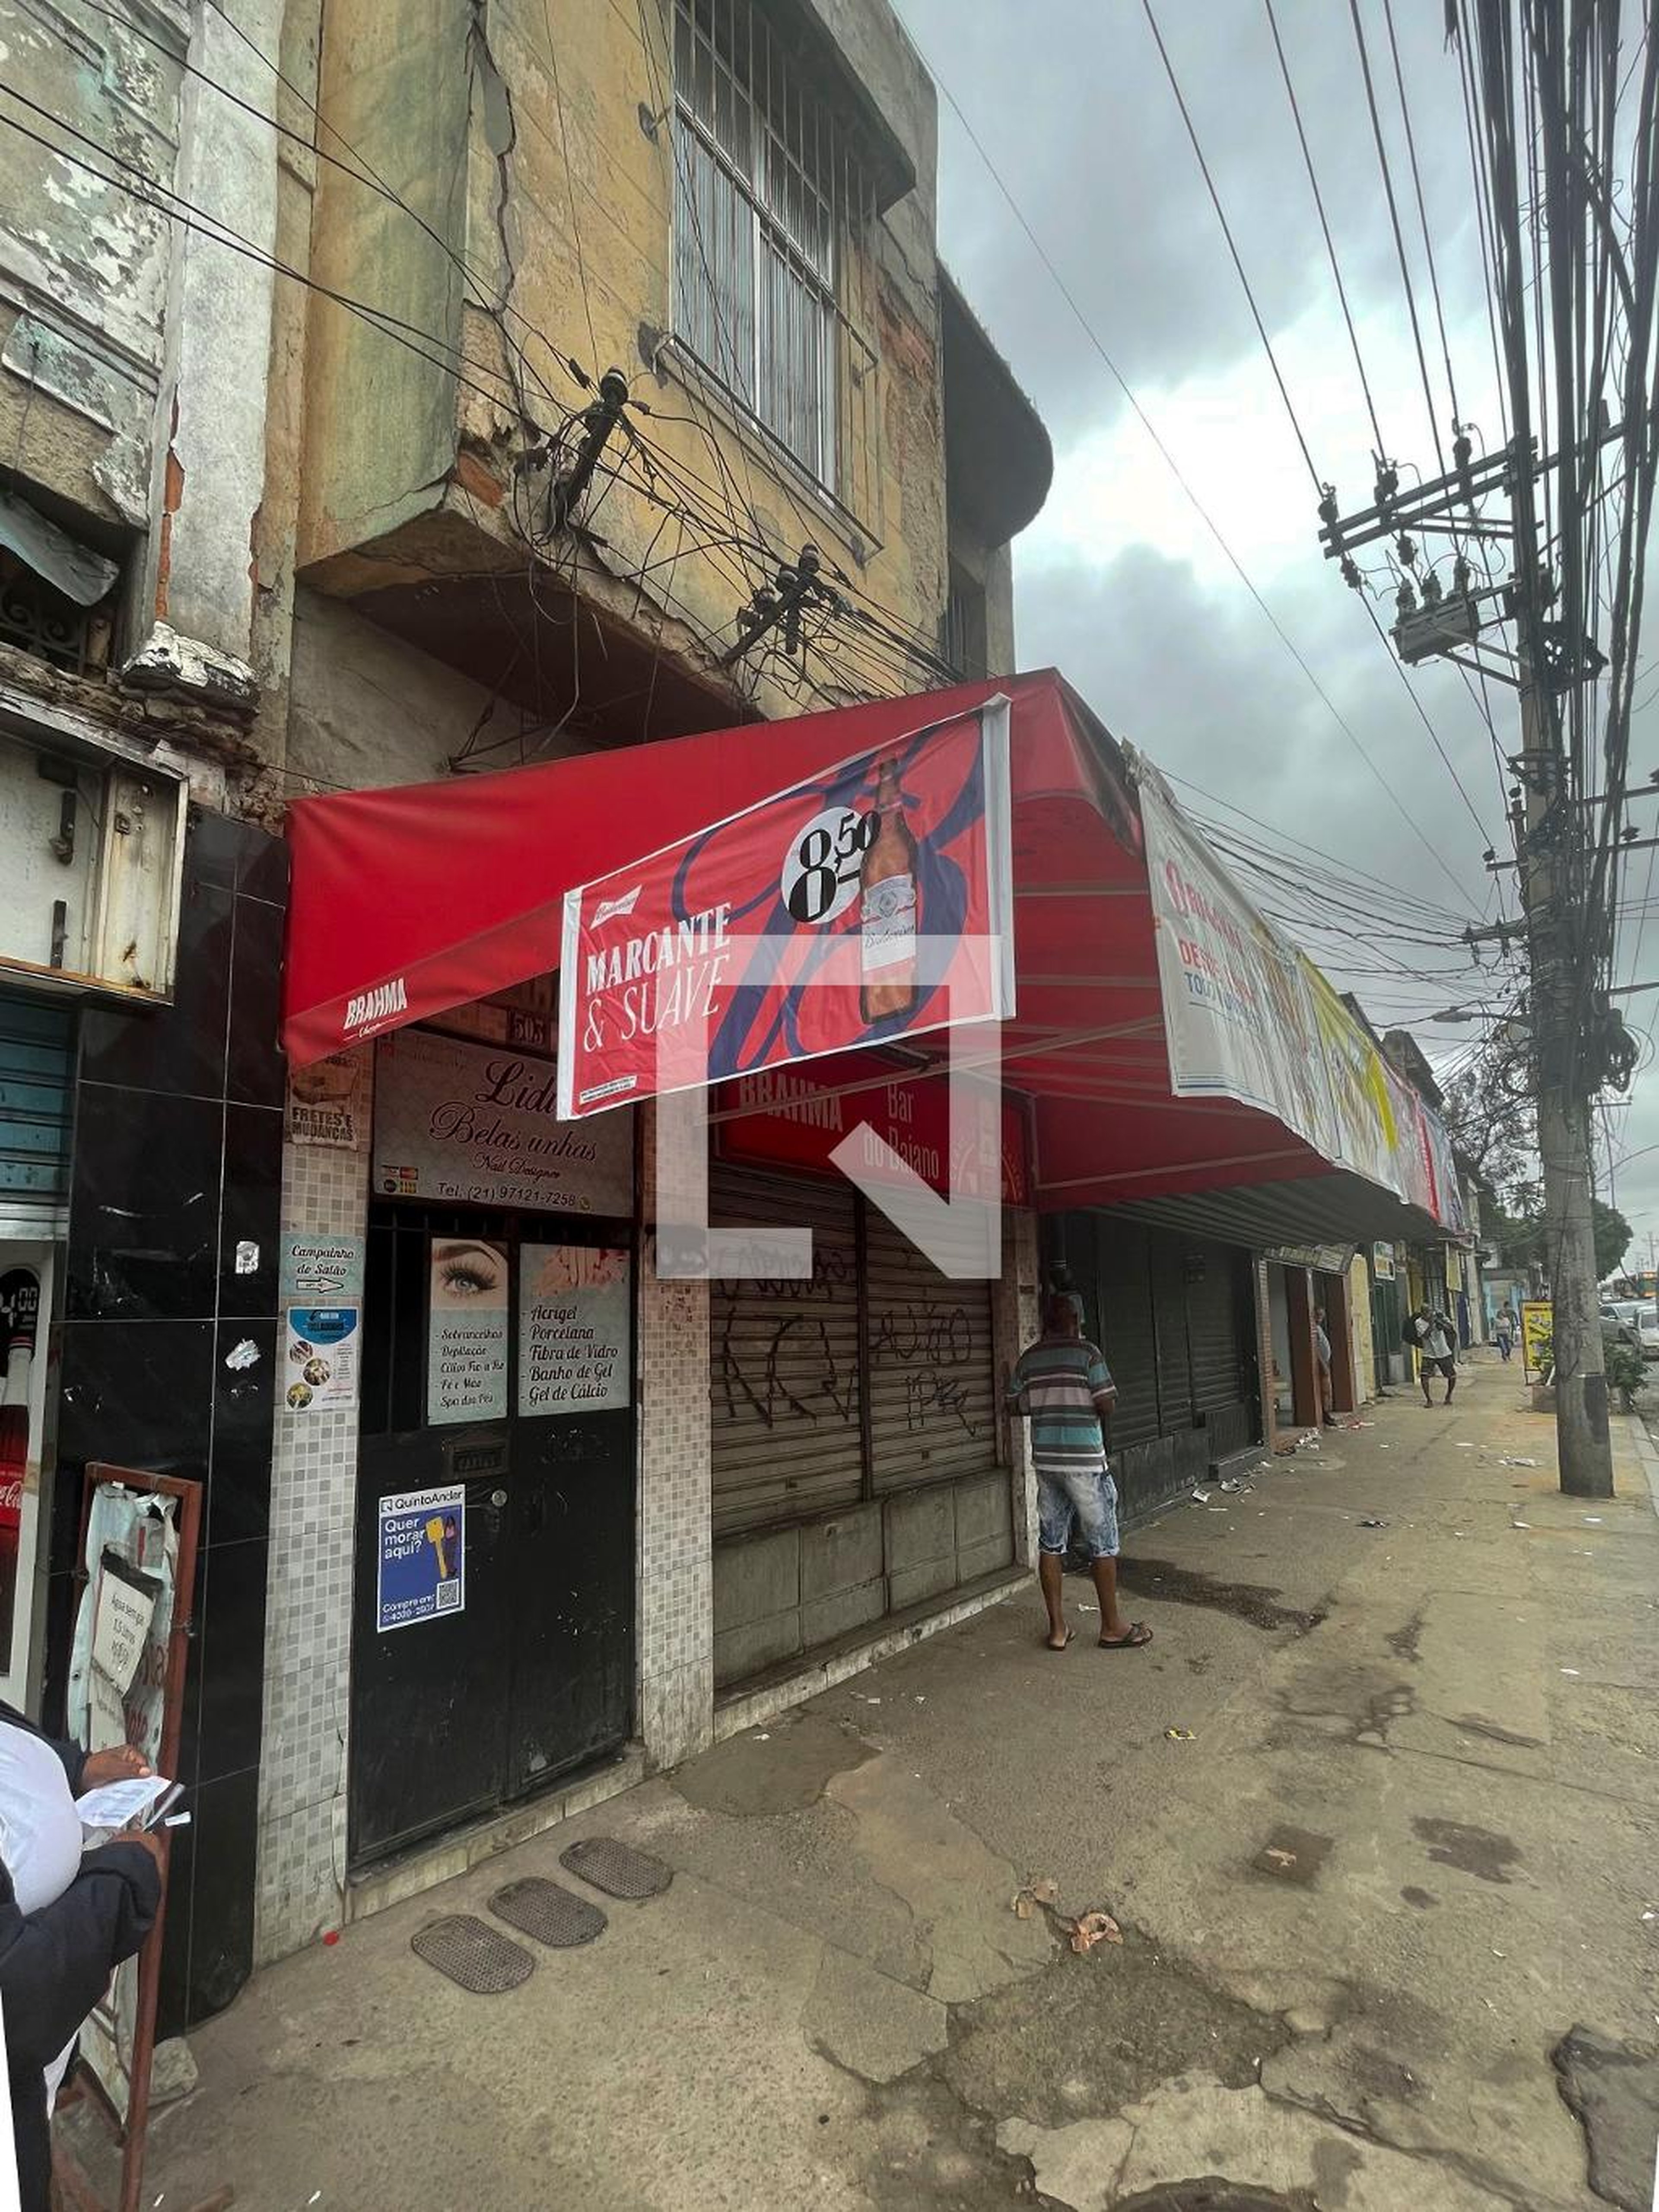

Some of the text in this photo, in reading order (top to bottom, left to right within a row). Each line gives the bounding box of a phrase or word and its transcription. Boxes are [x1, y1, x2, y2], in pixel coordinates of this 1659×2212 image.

[587, 902, 731, 996] MARCANTE
[343, 978, 407, 1030] BRAHMA
[584, 954, 729, 1053] & SUAVE
[887, 1083, 915, 1124] Bar
[429, 1101, 597, 1162] Belas unhas
[888, 1126, 939, 1181] Baiano
[467, 1186, 495, 1200] (21)
[531, 1305, 577, 1324] Acrigel
[530, 1324, 594, 1340] Porcelana
[530, 1343, 618, 1361] Fibra de Vidro
[530, 1362, 613, 1382] Banho de Gel
[529, 1385, 550, 1407] Gel
[552, 1385, 568, 1401] de
[395, 1491, 462, 1509] QuintoAndar
[385, 1517, 420, 1532] Quer
[385, 1528, 426, 1545] morar
[385, 1540, 422, 1559] aqui?
